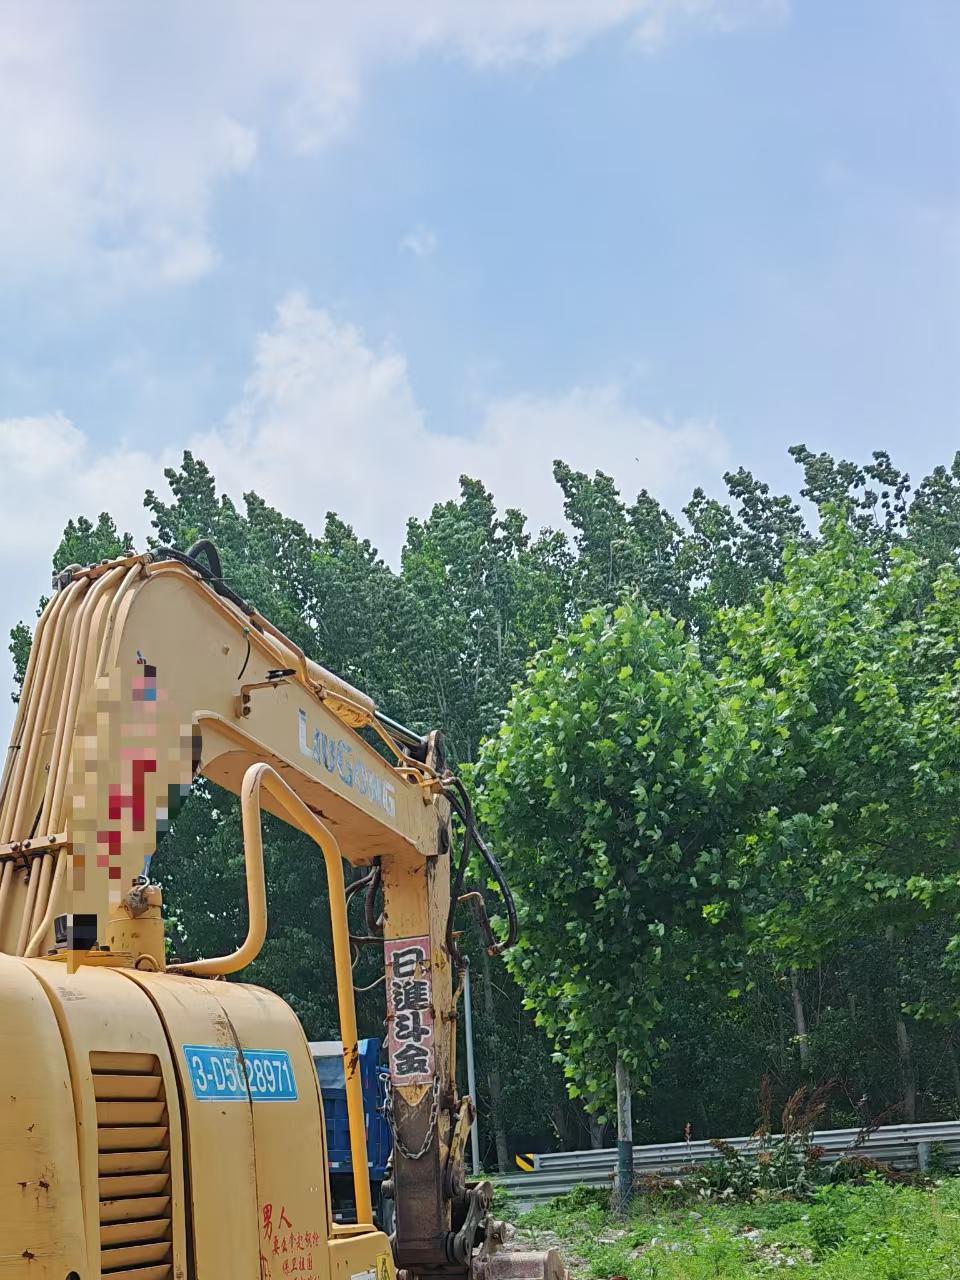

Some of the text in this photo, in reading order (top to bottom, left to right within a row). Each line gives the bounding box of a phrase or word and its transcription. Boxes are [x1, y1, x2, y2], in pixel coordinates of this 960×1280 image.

[392, 946, 430, 1076] 日進斗金
[263, 1203, 292, 1240] 男人
